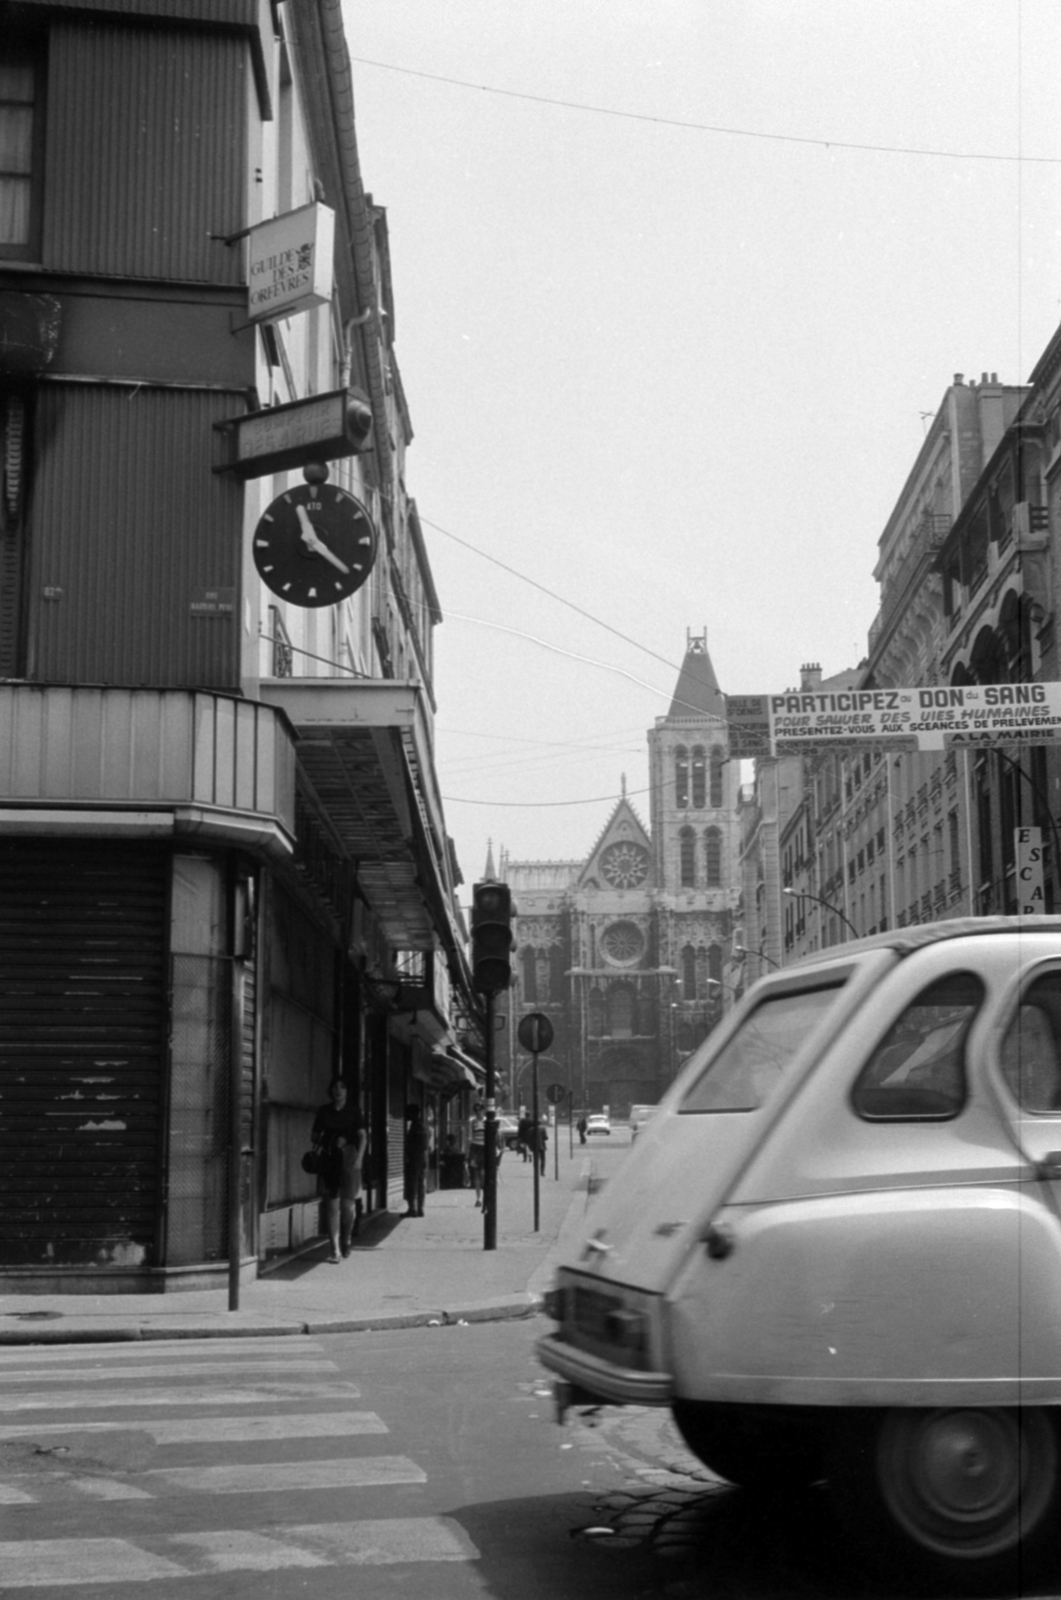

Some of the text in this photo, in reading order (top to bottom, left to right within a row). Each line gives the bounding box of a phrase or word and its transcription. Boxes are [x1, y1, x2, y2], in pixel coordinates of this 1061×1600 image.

[250, 248, 295, 276] GUILDE
[272, 263, 295, 282] DES
[306, 502, 322, 511] ATO
[751, 697, 761, 706] DE
[771, 691, 900, 714] PARTICIPEZ
[919, 688, 964, 708] DON
[966, 690, 979, 700] du
[984, 684, 1046, 705] SANG
[774, 715, 811, 728] POUR
[880, 711, 911, 724] DES
[960, 704, 1051, 720] HUMAINES
[774, 724, 876, 737] PRESENTEZ-VOUS
[881, 723, 904, 733] AUX
[909, 719, 969, 732] SCEANCES
[974, 719, 989, 729] DE
[952, 729, 1055, 742] A LA MAIRIE
